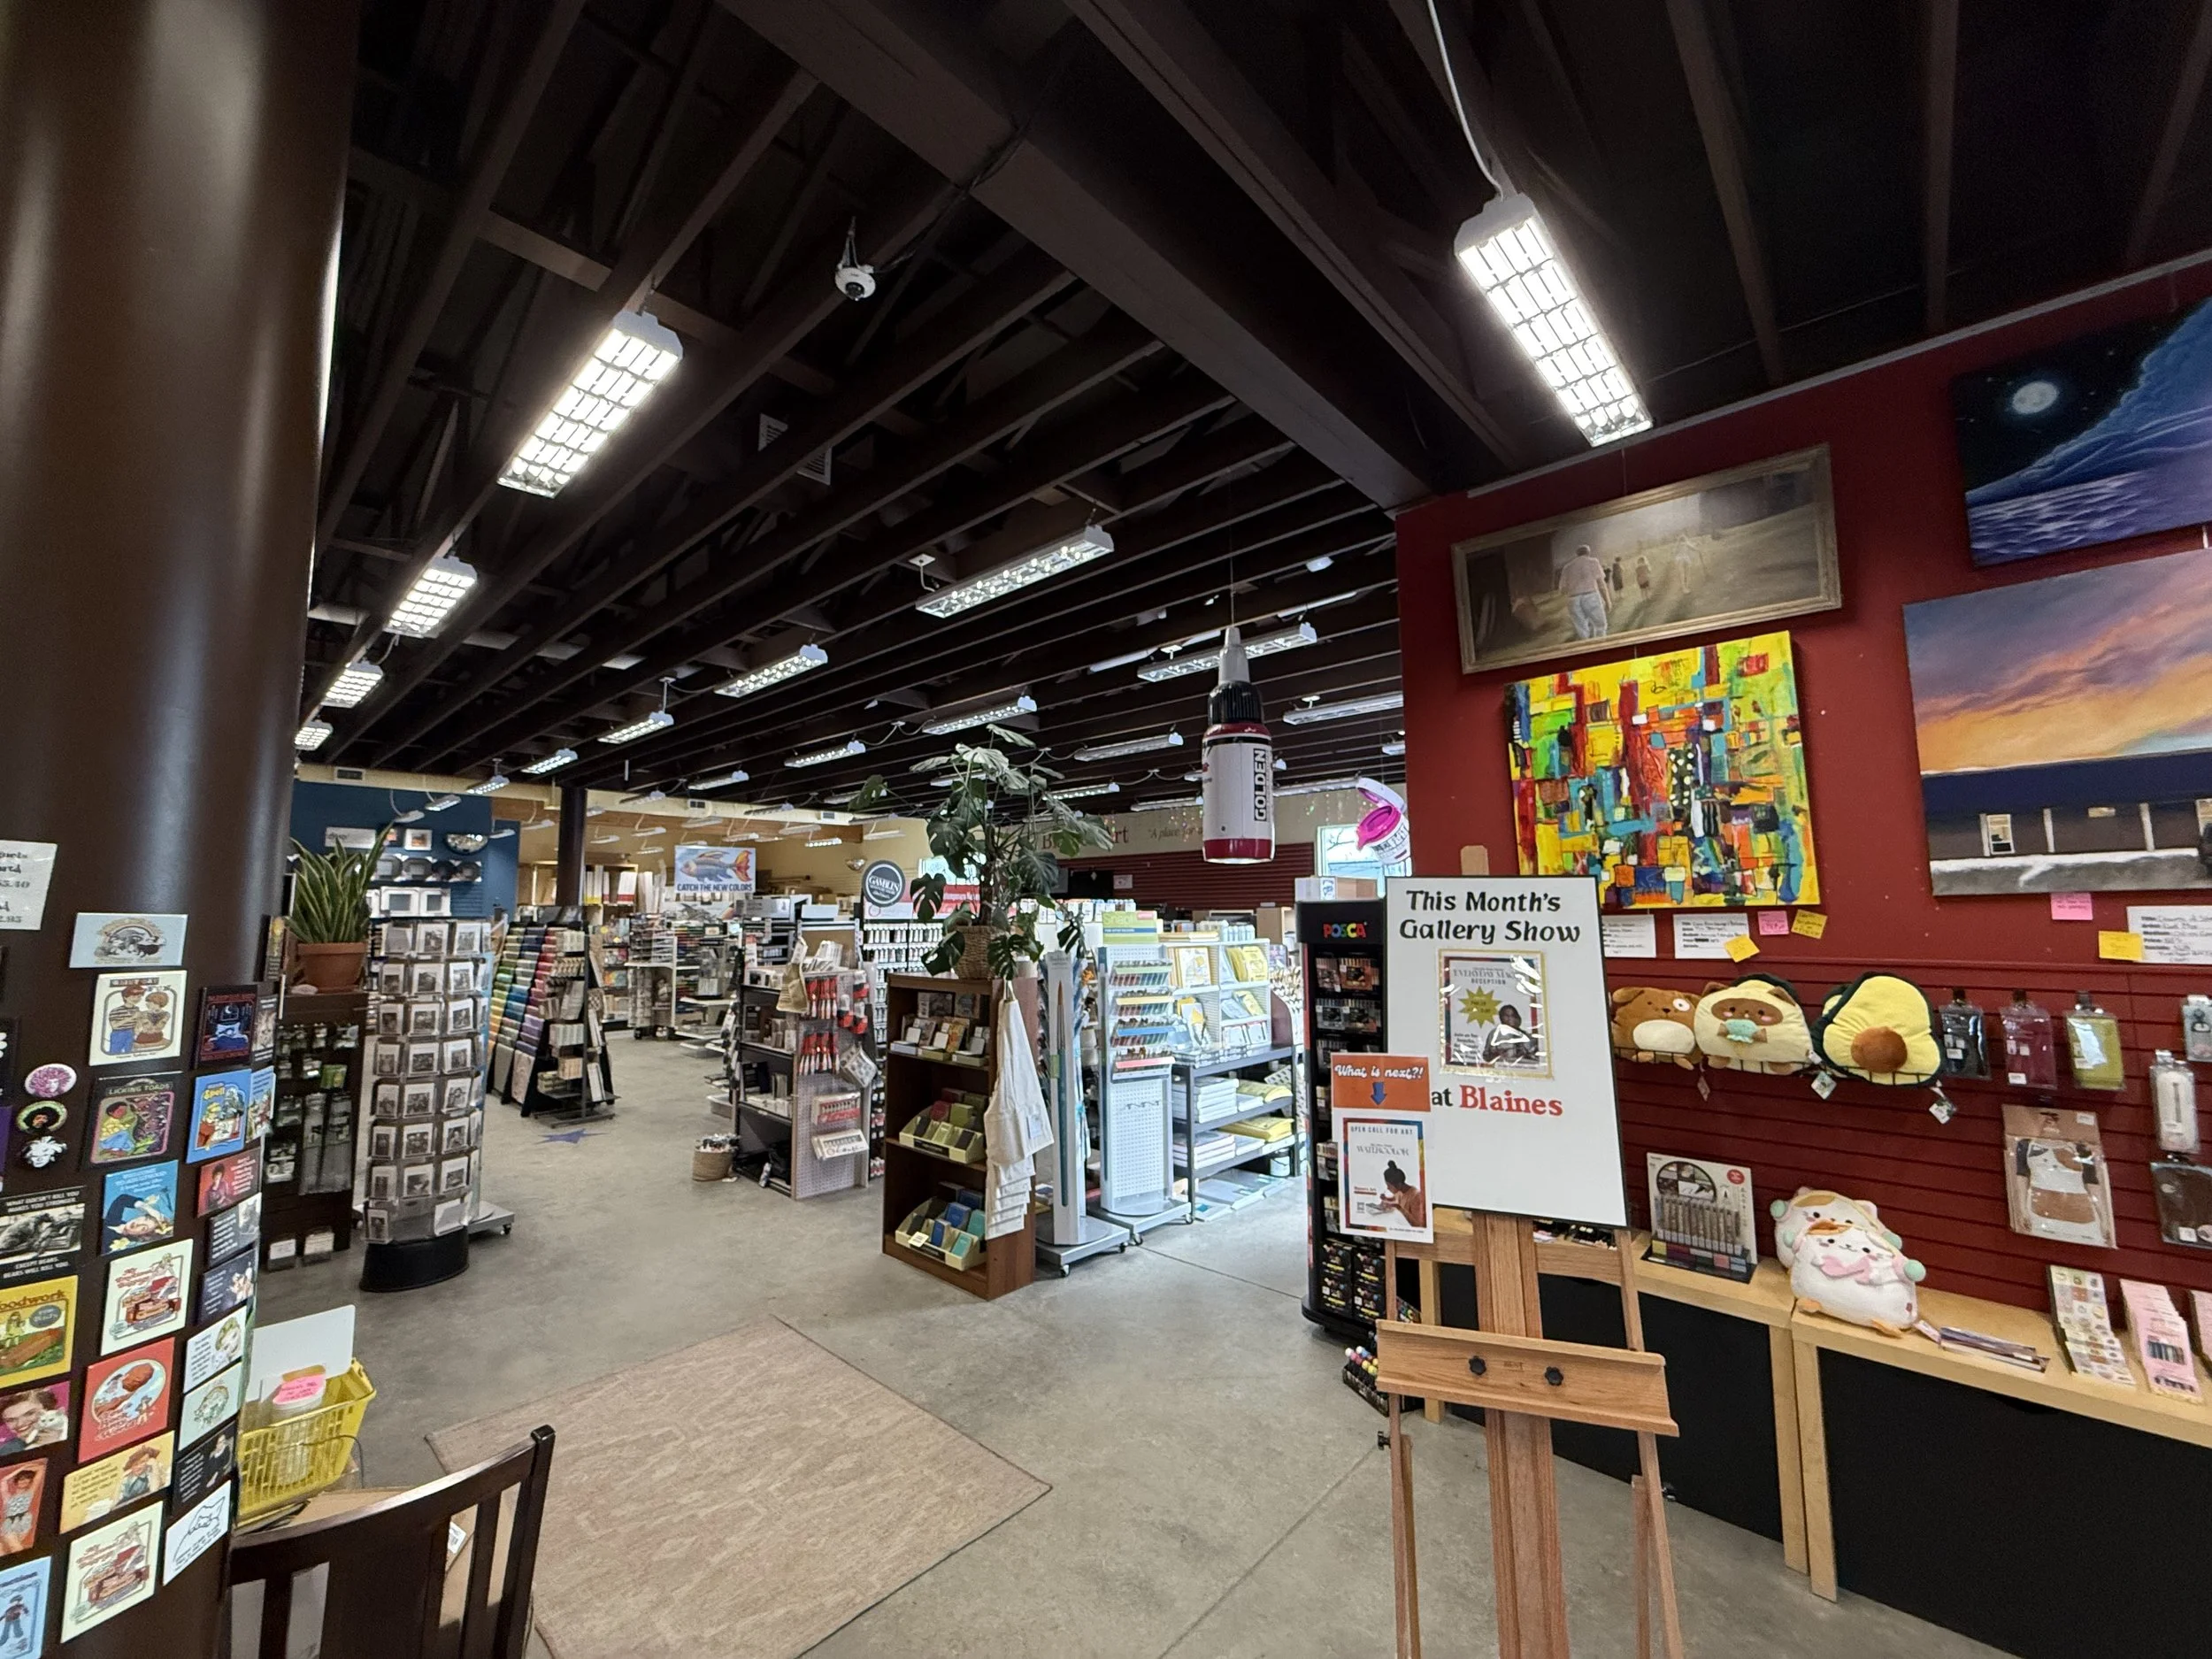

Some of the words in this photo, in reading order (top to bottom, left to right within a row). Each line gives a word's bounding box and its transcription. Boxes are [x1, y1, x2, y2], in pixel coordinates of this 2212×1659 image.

[1255, 749, 1266, 821] GOLDEN
[677, 883, 699, 893] CATCH
[700, 883, 711, 892] THE
[712, 883, 728, 893] NEW
[729, 883, 753, 893] COLORS
[869, 876, 900, 892] GAMBLIN
[1406, 890, 1456, 911] This
[1465, 890, 1561, 912] Month's
[1323, 923, 1366, 939] POSCA
[1400, 918, 1495, 944] Gallery
[1504, 920, 1580, 942] Show
[1334, 1064, 1367, 1079] What
[1371, 1065, 1380, 1078] is
[1385, 1067, 1424, 1080] next?!
[109, 1086, 143, 1094] LICKING
[1432, 1090, 1453, 1107] at
[1460, 1085, 1563, 1117] Blaines
[1356, 1145, 1409, 1156] WATERCOLOR
[14, 1260, 38, 1270] EXCEPT
[0, 1289, 66, 1310] oodwork
